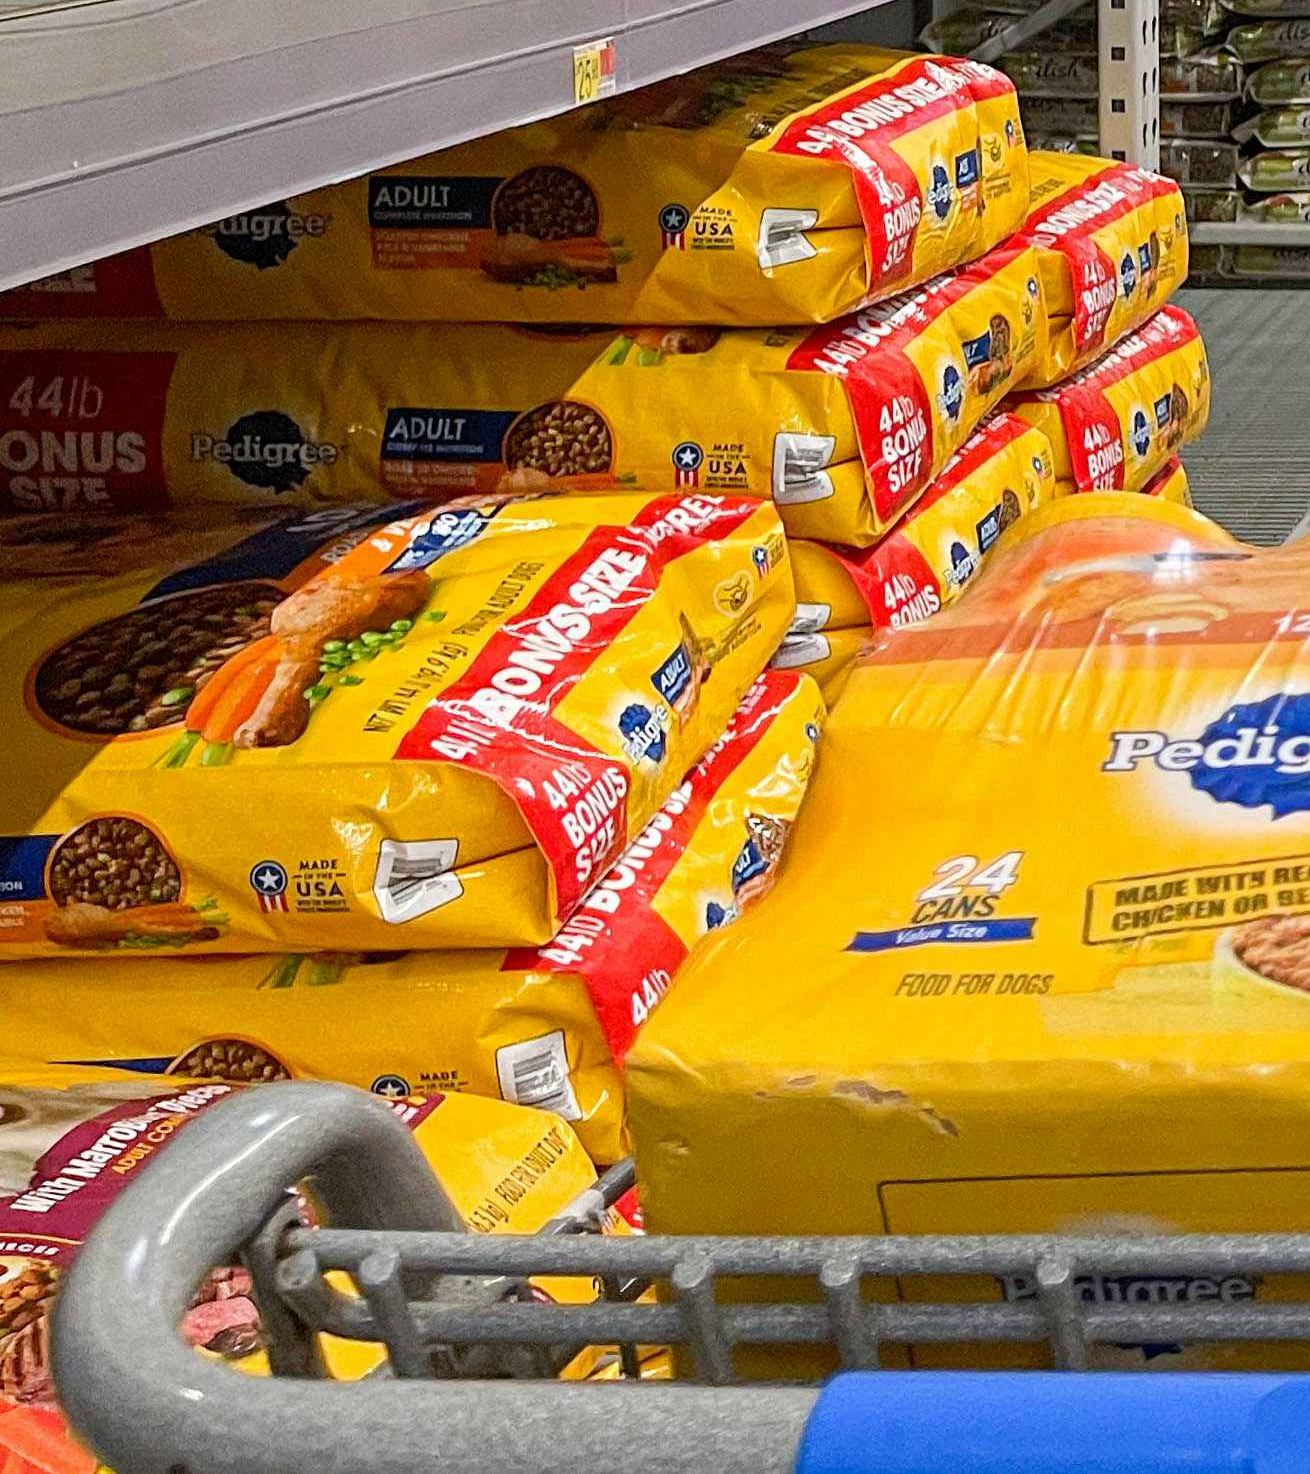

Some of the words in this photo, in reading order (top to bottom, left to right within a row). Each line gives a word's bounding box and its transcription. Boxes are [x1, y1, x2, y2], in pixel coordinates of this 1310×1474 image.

[841, 93, 915, 137] BONUS
[373, 184, 452, 210] ADULT
[701, 207, 733, 217] MADE
[694, 222, 734, 236] USA
[883, 196, 920, 239] BONUS
[1044, 197, 1095, 236] BONUS
[1083, 278, 1117, 313] BONUS
[8, 374, 104, 422] 44lb
[879, 394, 915, 430] 44lb
[388, 417, 467, 440] ADULT
[882, 407, 928, 464] BONUS
[1083, 423, 1111, 452] 44lb
[191, 432, 339, 466] Pedigree
[713, 444, 745, 453] MADE
[1087, 439, 1124, 480] BONUS
[708, 461, 748, 475] USA
[884, 573, 917, 611] 44lb
[889, 583, 941, 631] BONUS
[468, 606, 592, 726] BONUS
[567, 544, 648, 616] SIZE
[659, 646, 688, 695] ADULT
[541, 760, 593, 812] 44lb
[561, 766, 628, 850] BONUS
[300, 859, 337, 870] MADE
[916, 850, 1025, 904] 24
[296, 880, 344, 898] USA
[1113, 877, 1190, 908] MADE
[1196, 869, 1267, 897] WITH
[910, 895, 1002, 925] CANS
[1111, 899, 1227, 934] CHICKEN
[1233, 892, 1271, 918] OR
[537, 913, 605, 966] 44lb
[896, 923, 945, 945] Value
[944, 921, 991, 943] Size
[894, 973, 952, 997] FOOD
[951, 973, 996, 996] FOR
[995, 972, 1056, 997] DOGS
[419, 1070, 460, 1082] MADE
[111, 1140, 155, 1177] ADULT
[9, 1164, 70, 1216] With
